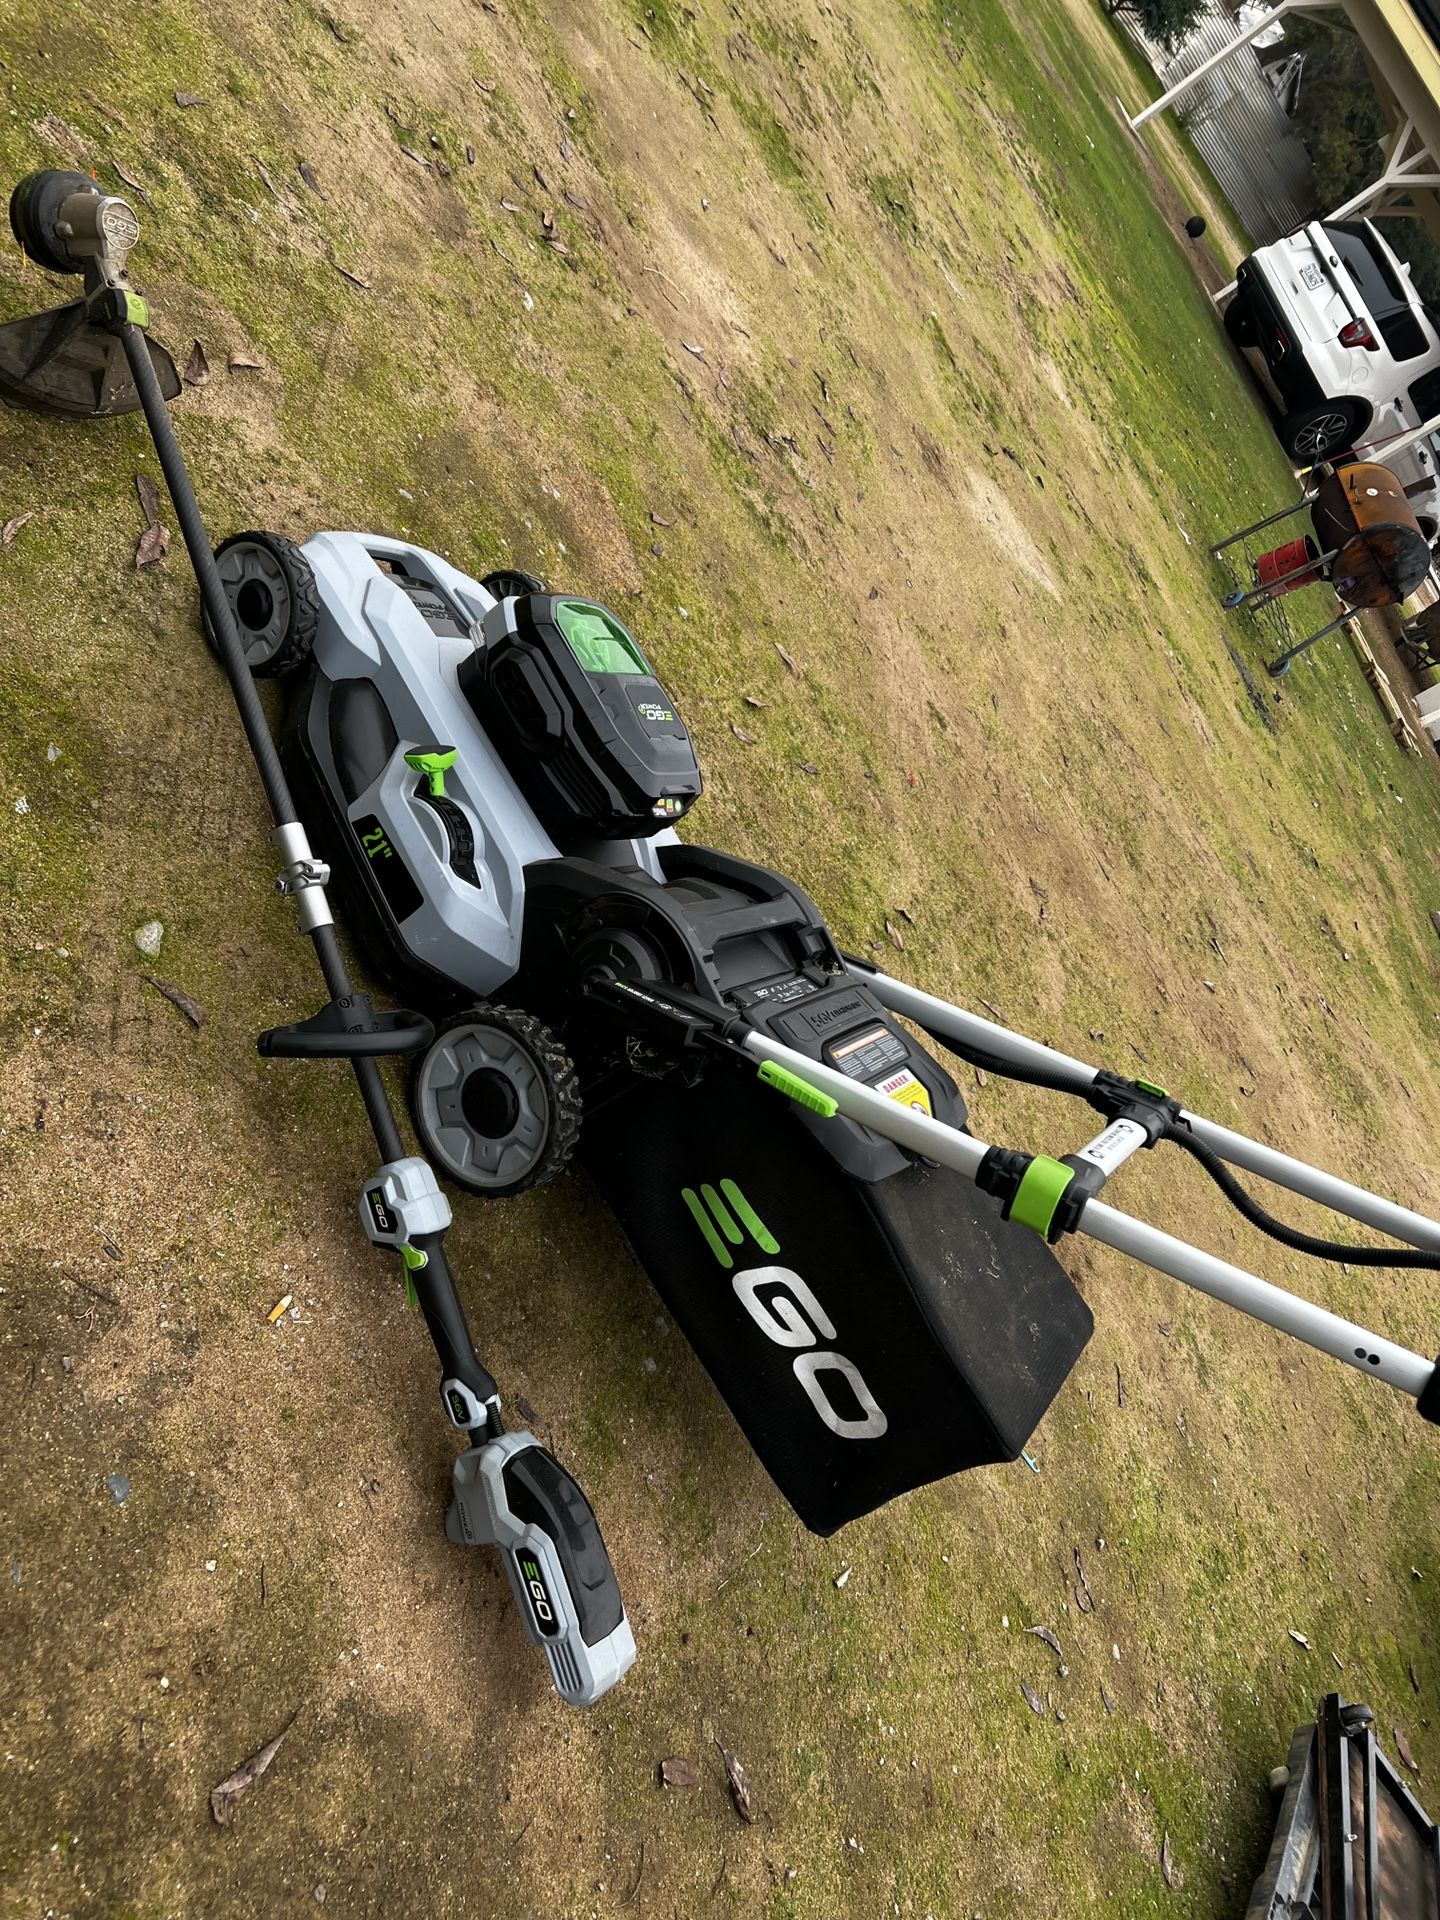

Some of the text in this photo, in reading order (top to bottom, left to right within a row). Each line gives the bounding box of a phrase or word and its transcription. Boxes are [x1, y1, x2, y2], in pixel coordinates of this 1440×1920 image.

[107, 217, 138, 236] EGO
[420, 609, 457, 621] EGO
[646, 710, 674, 721] EGO
[362, 827, 393, 858] 21"
[882, 1074, 909, 1093] DANGER
[371, 1192, 389, 1228] EGO
[681, 1178, 888, 1439] EGO
[452, 1394, 466, 1420] 56V
[460, 1502, 469, 1535] POWER
[522, 1561, 553, 1621] EGO
